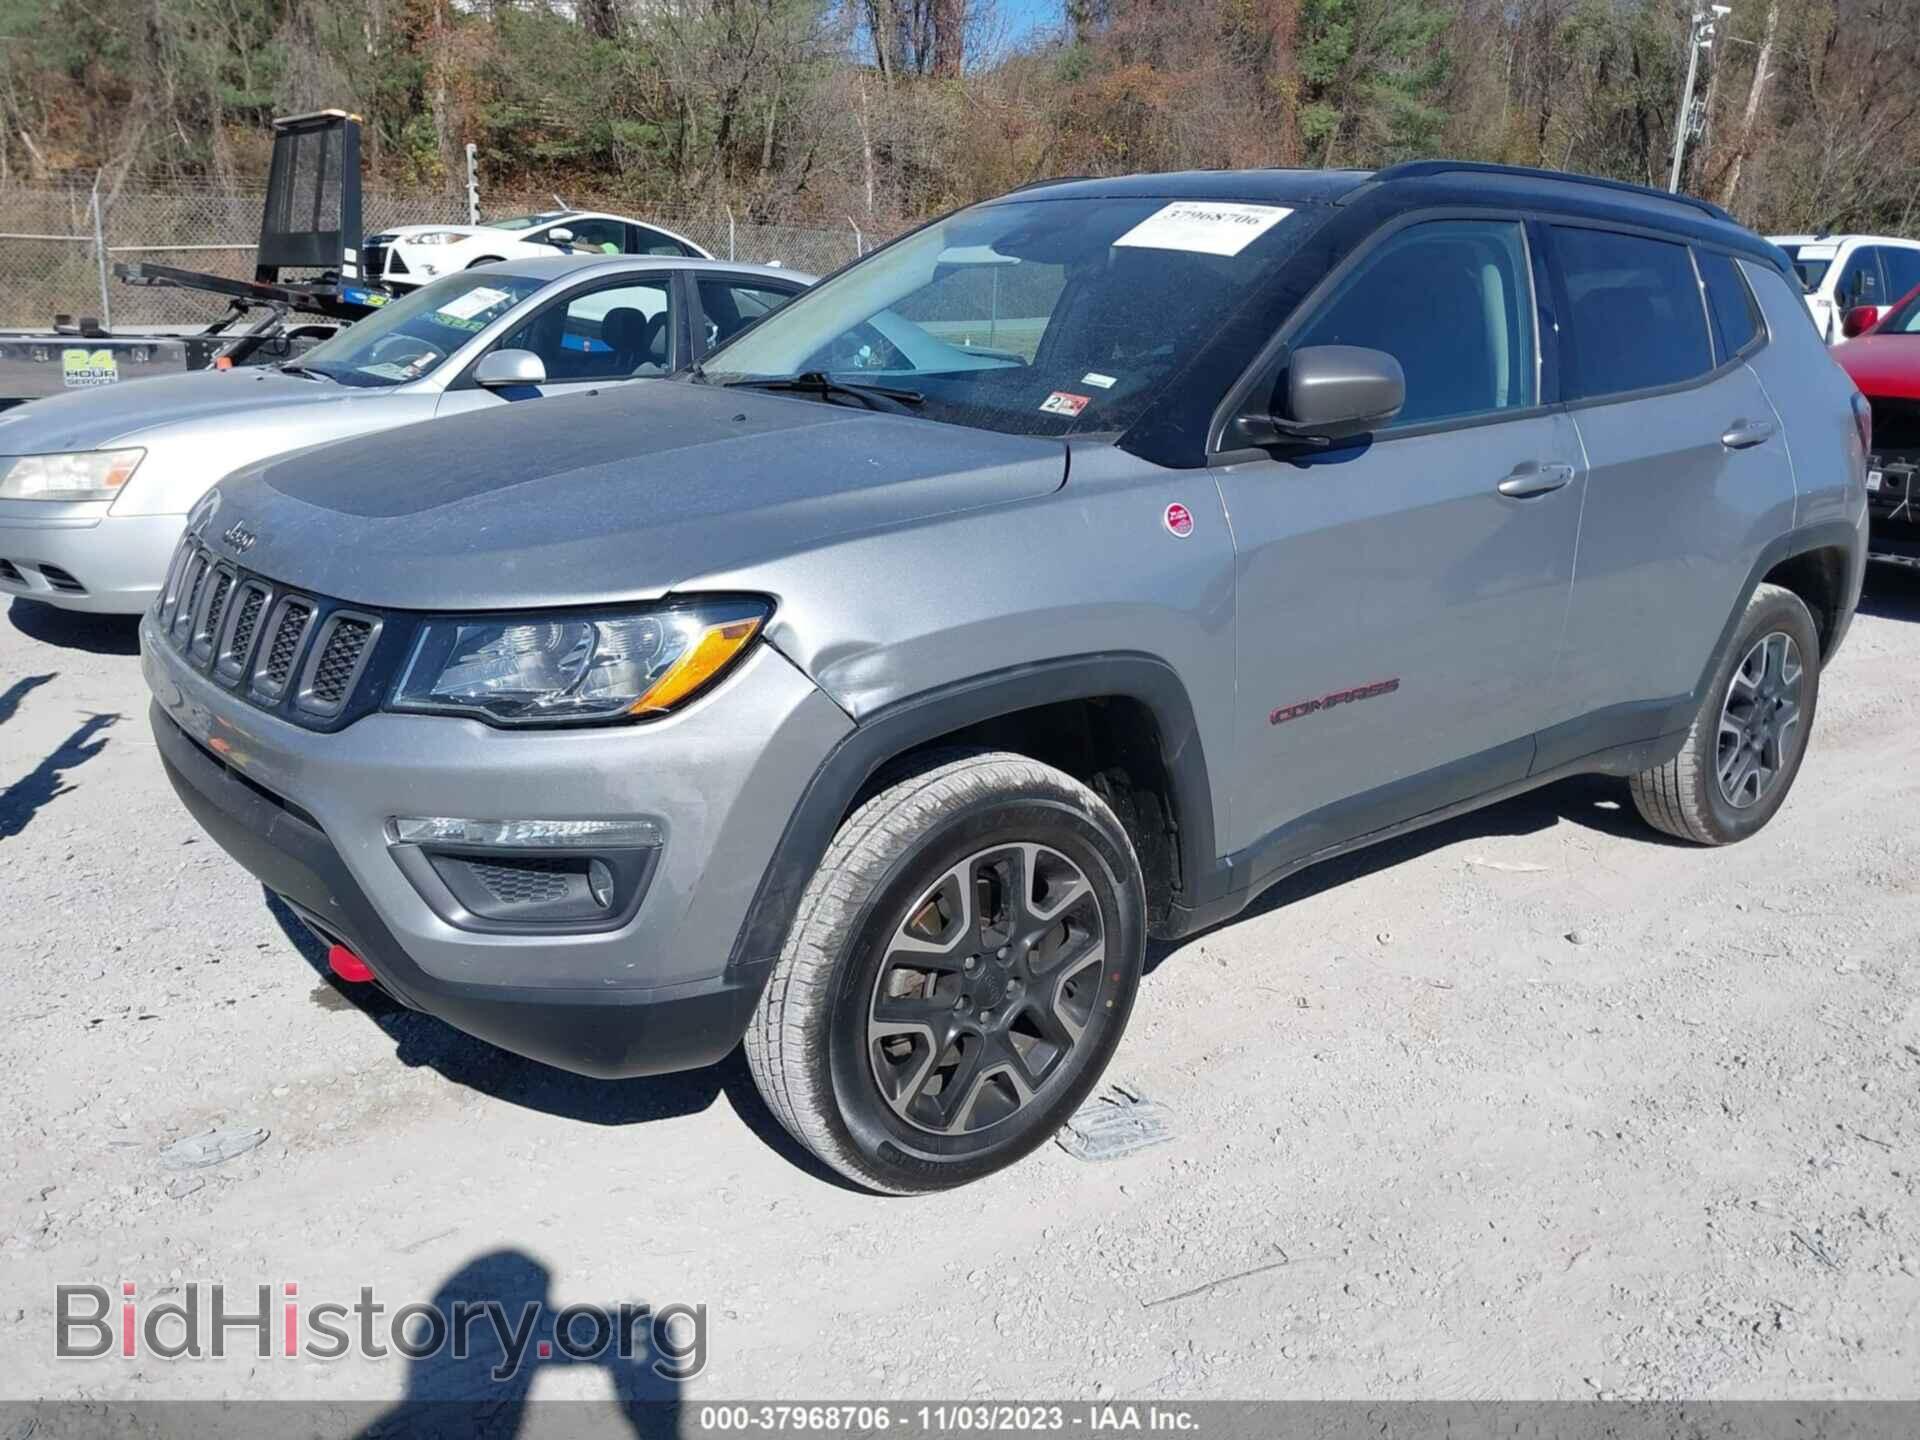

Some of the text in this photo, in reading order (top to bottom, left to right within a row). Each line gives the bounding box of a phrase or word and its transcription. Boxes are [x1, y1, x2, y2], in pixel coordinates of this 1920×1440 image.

[63, 349, 115, 369] 24
[65, 369, 117, 378] HOUR
[223, 519, 257, 555] Jeep
[1269, 677, 1401, 726] COMPASS
